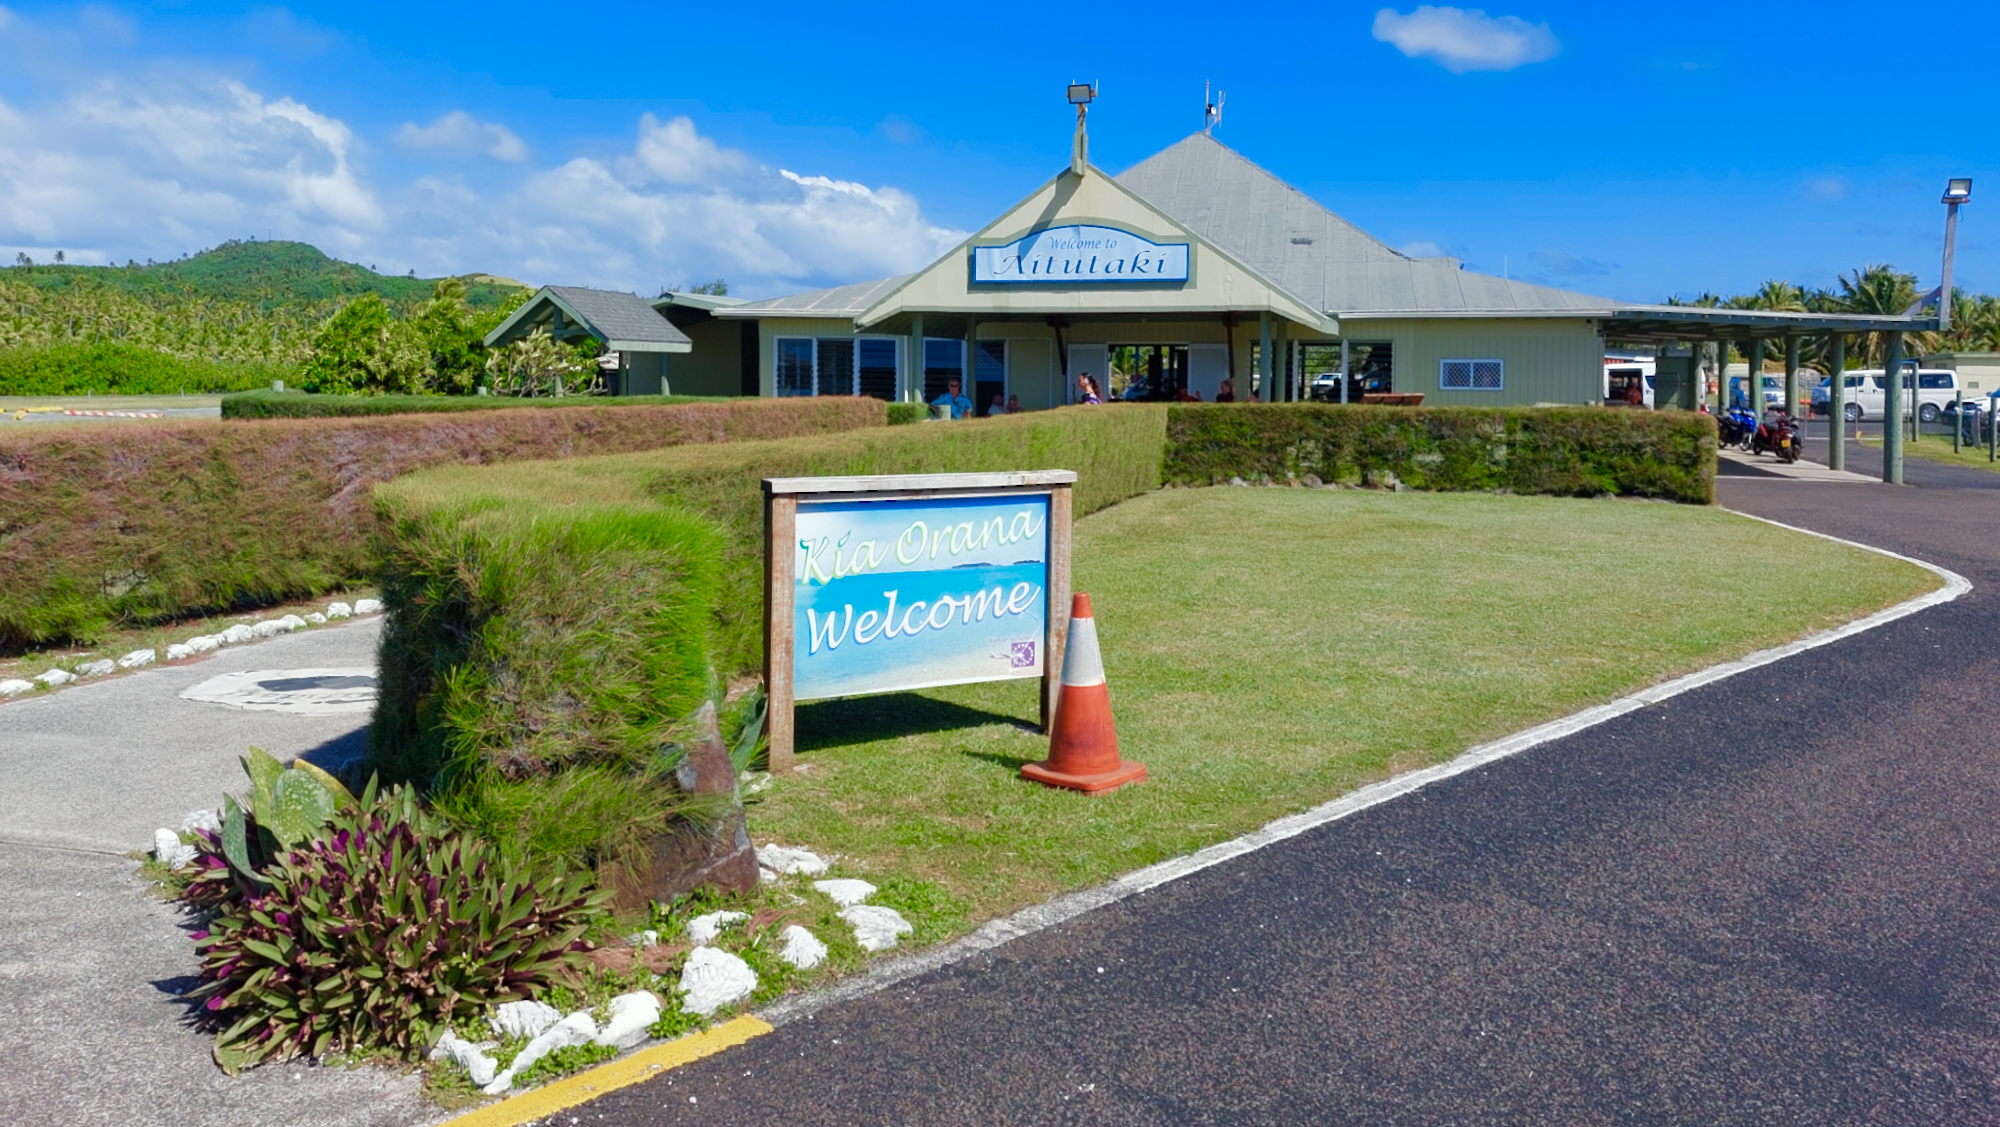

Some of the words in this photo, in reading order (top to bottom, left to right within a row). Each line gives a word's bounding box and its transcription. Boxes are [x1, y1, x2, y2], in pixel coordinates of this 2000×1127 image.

[993, 250, 1168, 275] Aitutaki
[1049, 236, 1101, 250] Welcome
[1105, 238, 1118, 249] to
[800, 530, 890, 585] Kia
[895, 509, 1044, 565] Orana
[806, 581, 1042, 657] Welcome
